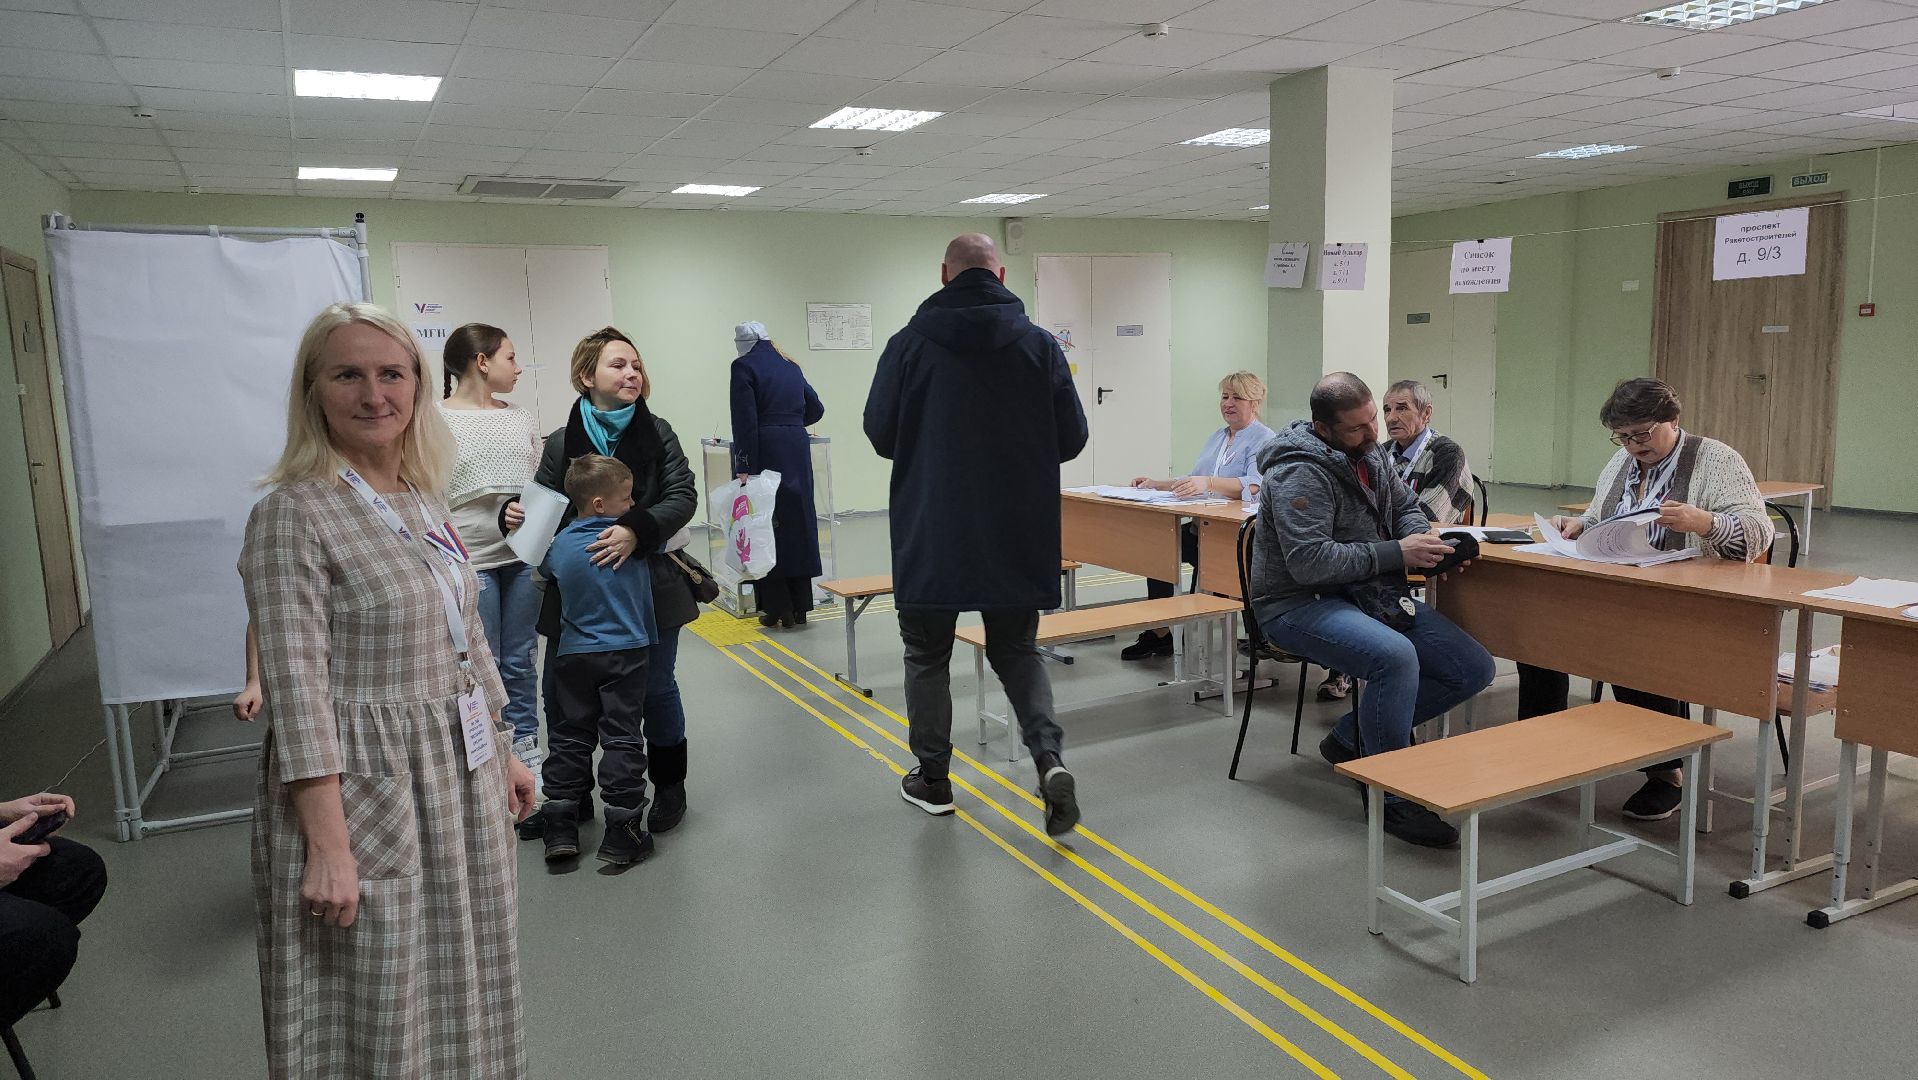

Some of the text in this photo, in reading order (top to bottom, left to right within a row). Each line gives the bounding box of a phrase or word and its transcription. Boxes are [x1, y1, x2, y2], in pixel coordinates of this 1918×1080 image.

[1793, 174, 1827, 186] ВЫХОД
[1740, 222, 1782, 234] проспект
[1724, 231, 1797, 245] Ракетостроителей
[1464, 251, 1495, 259] Список
[1736, 245, 1782, 266] д. 9/3
[1472, 265, 1496, 274] месту
[416, 328, 446, 338] МГН
